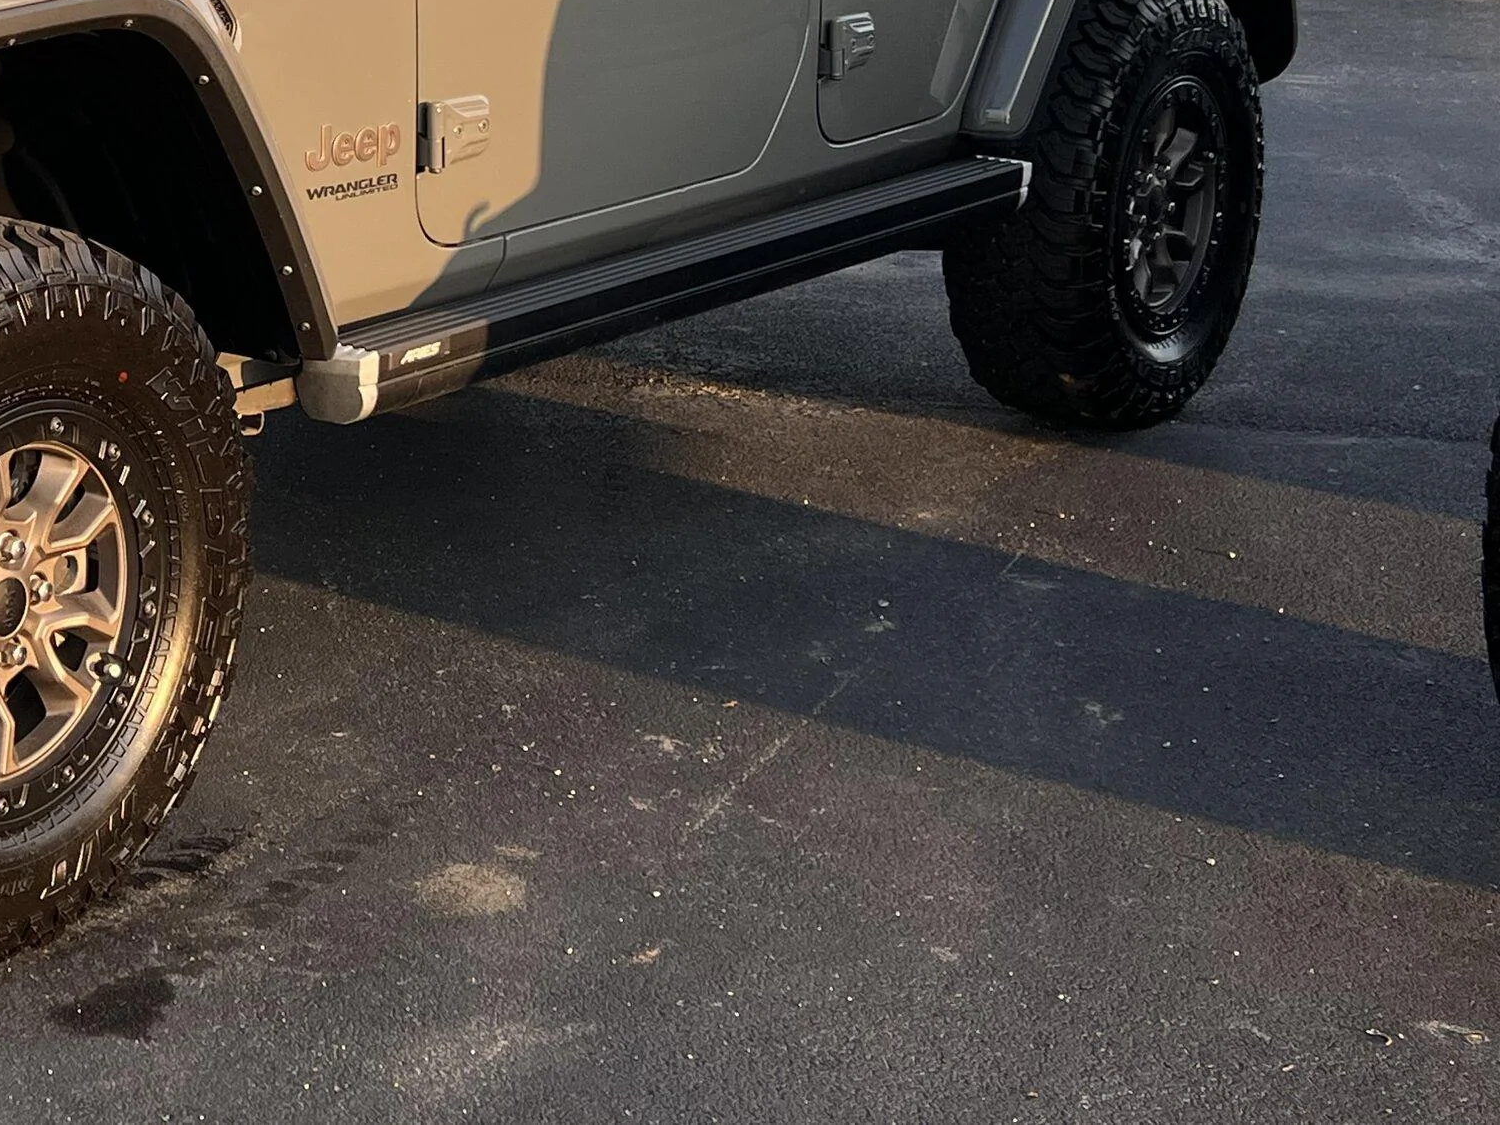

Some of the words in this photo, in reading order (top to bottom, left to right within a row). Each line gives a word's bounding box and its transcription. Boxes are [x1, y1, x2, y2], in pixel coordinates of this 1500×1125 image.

[304, 122, 401, 172] Jeep
[306, 173, 398, 201] WRANGLER
[335, 184, 398, 201] UNLIMITED
